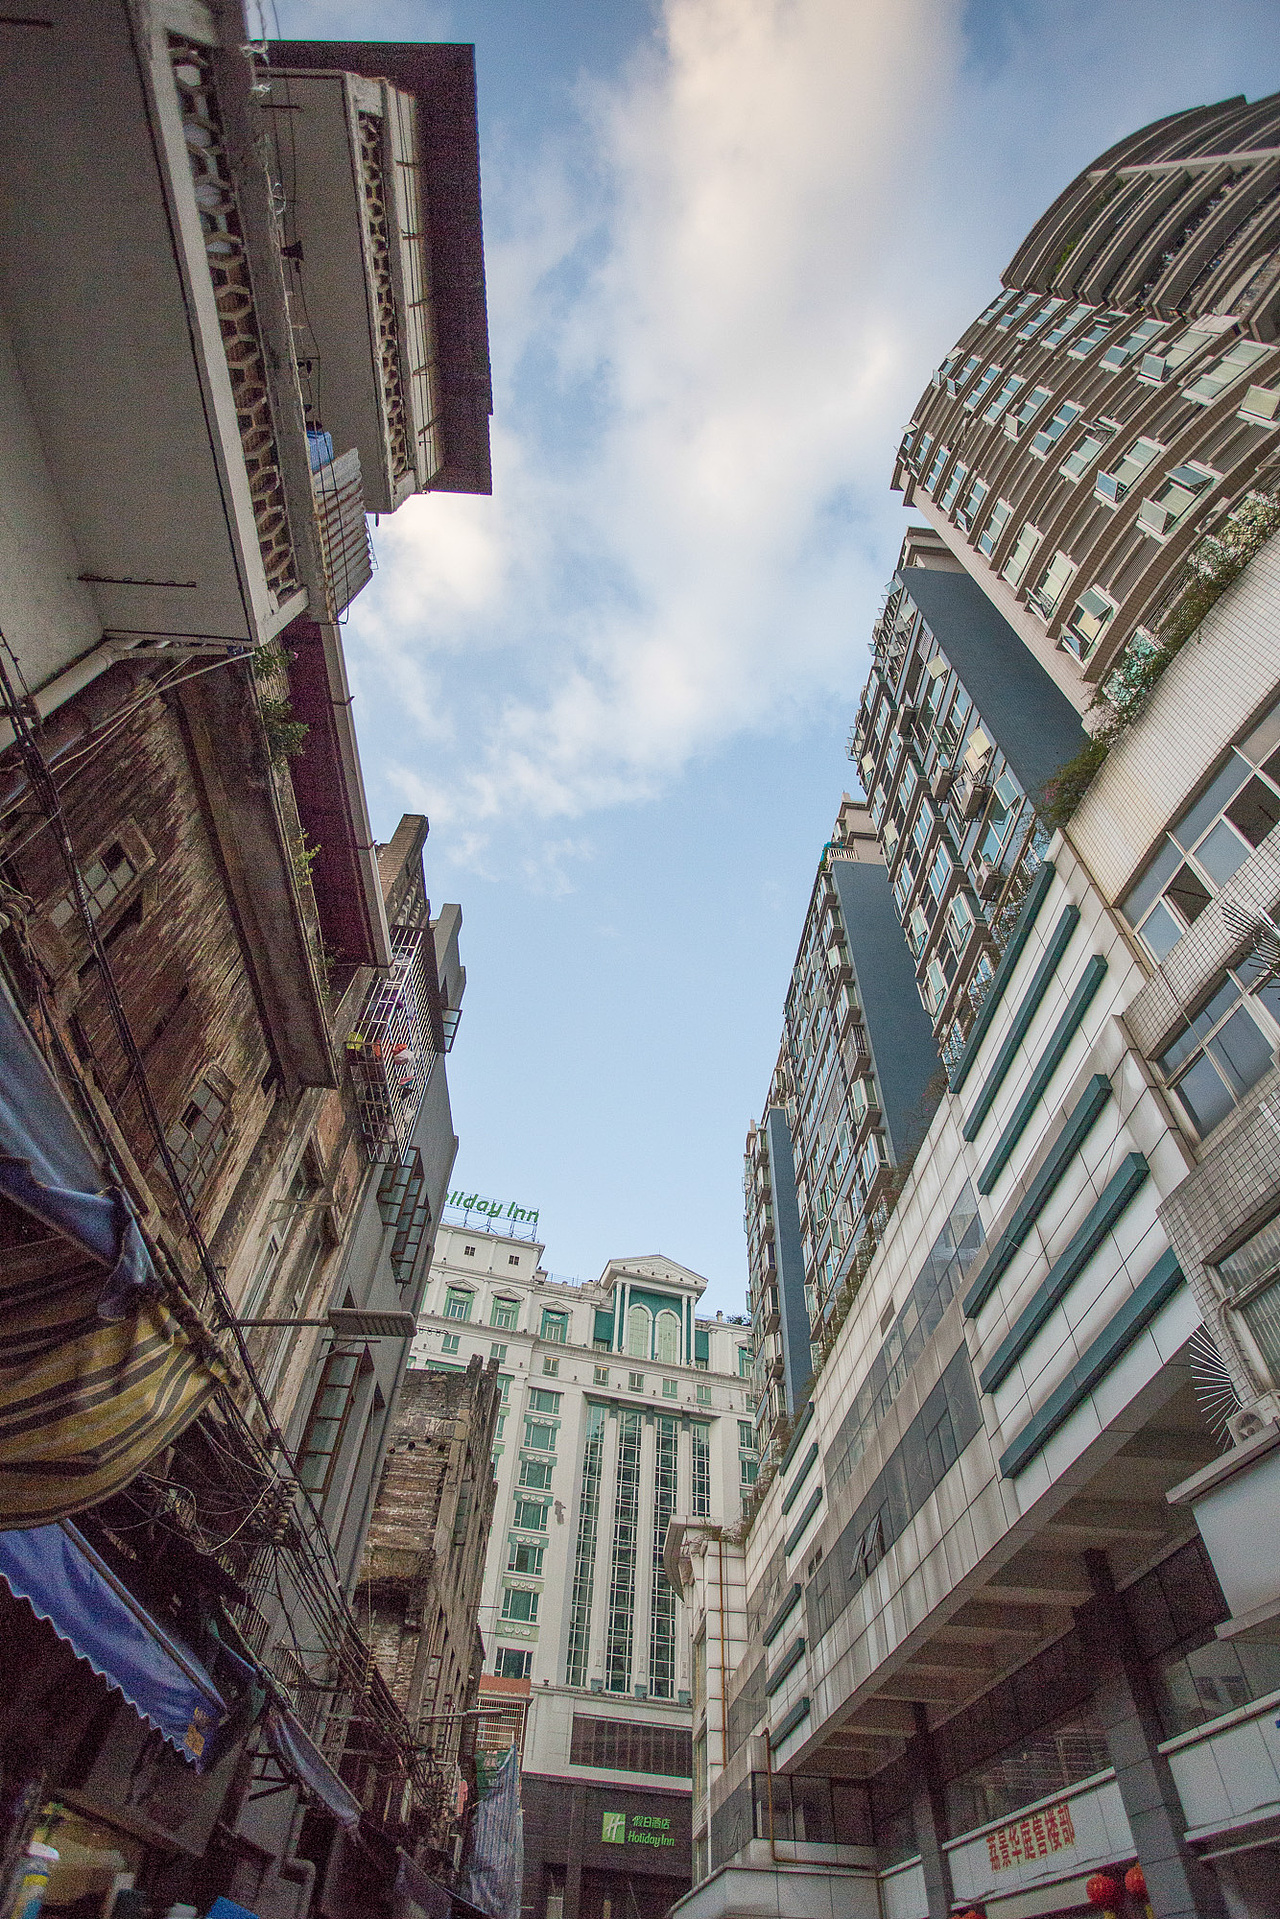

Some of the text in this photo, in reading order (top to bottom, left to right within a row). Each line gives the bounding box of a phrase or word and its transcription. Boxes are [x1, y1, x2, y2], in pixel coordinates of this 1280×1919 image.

[507, 1201, 539, 1223] Inn
[632, 1816, 671, 1829] 假日酒店
[628, 1831, 675, 1847] Holiday Inn
